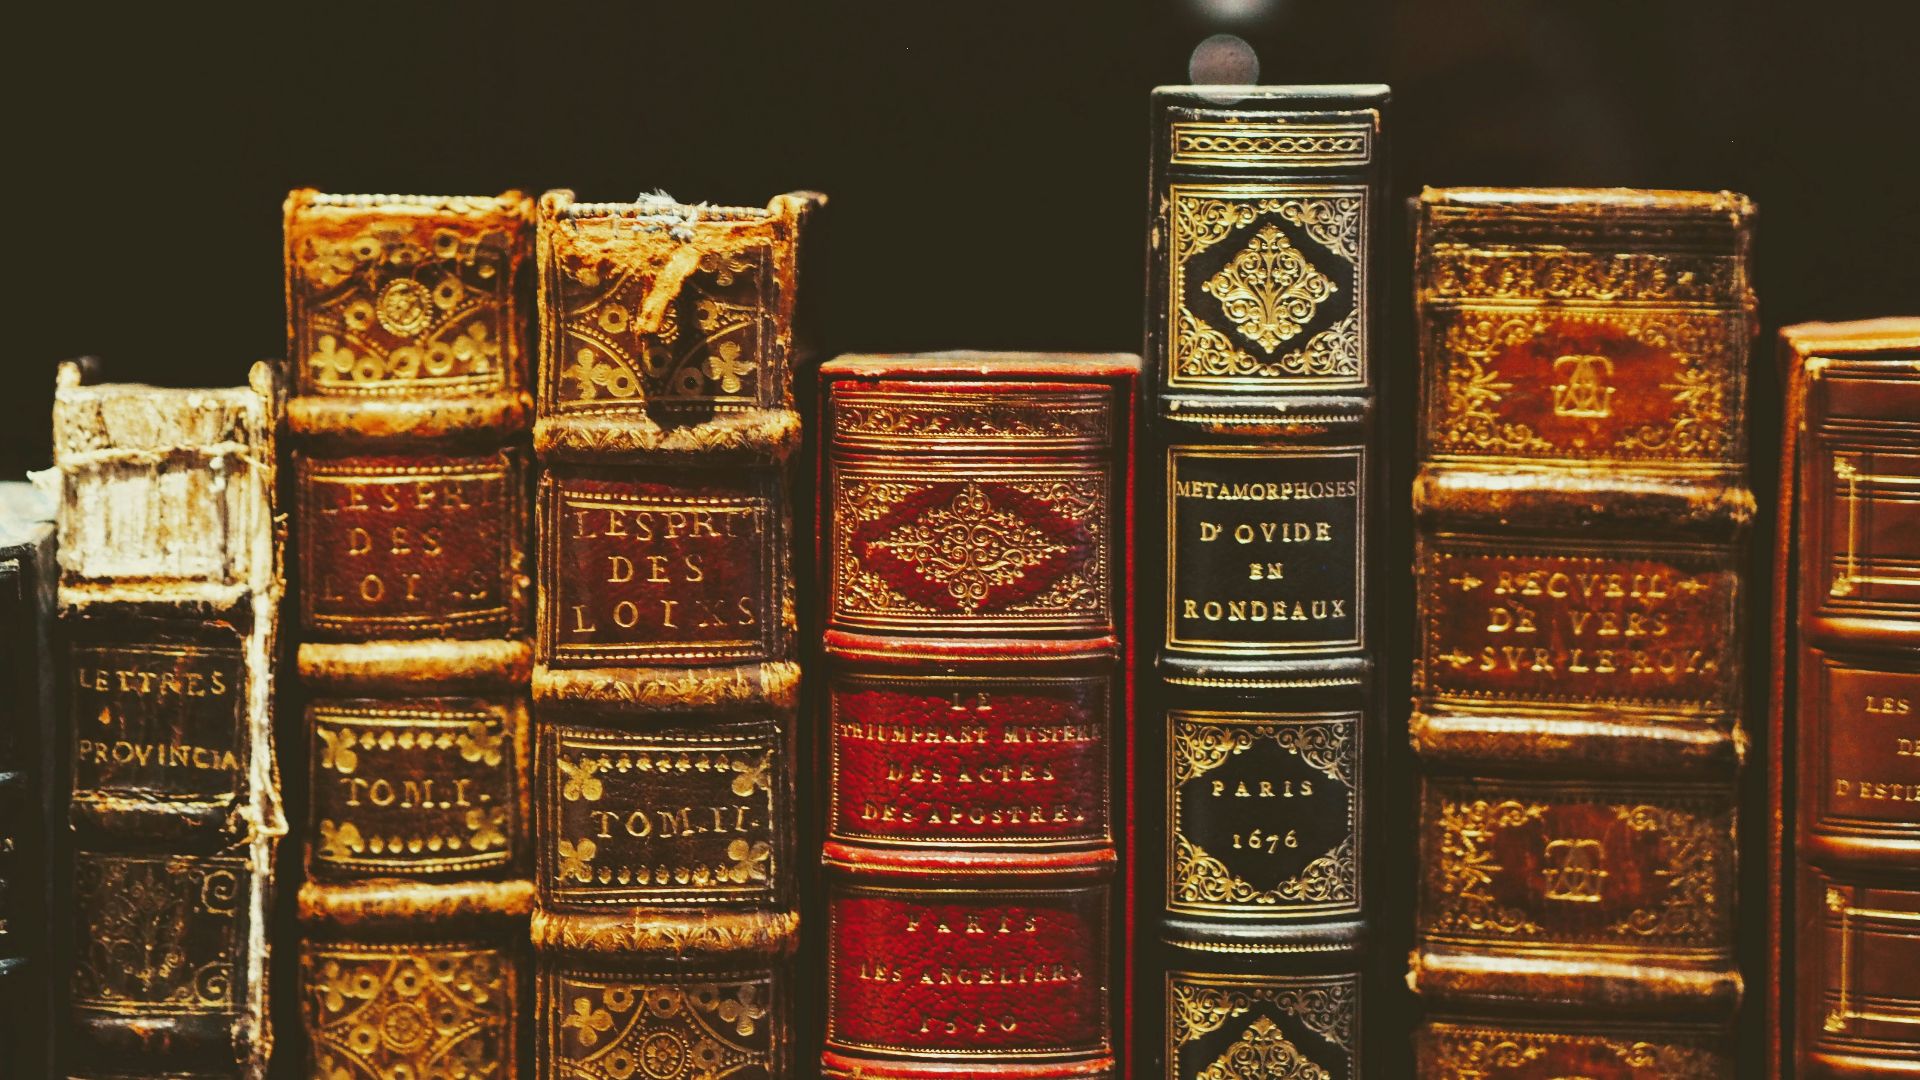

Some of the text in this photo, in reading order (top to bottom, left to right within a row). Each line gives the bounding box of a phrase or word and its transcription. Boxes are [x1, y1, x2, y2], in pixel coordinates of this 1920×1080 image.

[1176, 480, 1357, 501] METAMORPHOSES
[349, 527, 442, 556] DES
[607, 555, 704, 583] DES
[1249, 562, 1284, 581] EN
[572, 597, 755, 633] LOIXS
[1183, 599, 1346, 622] RONDEAUX
[1487, 607, 1667, 636] DE VERS
[1480, 646, 1554, 673] SVR
[1568, 648, 1616, 673] LE
[78, 667, 227, 697] LETTRES
[951, 692, 993, 711] LE
[1865, 695, 1911, 715] LES
[1211, 780, 1314, 798] PARIS
[1232, 828, 1298, 855] 1676
